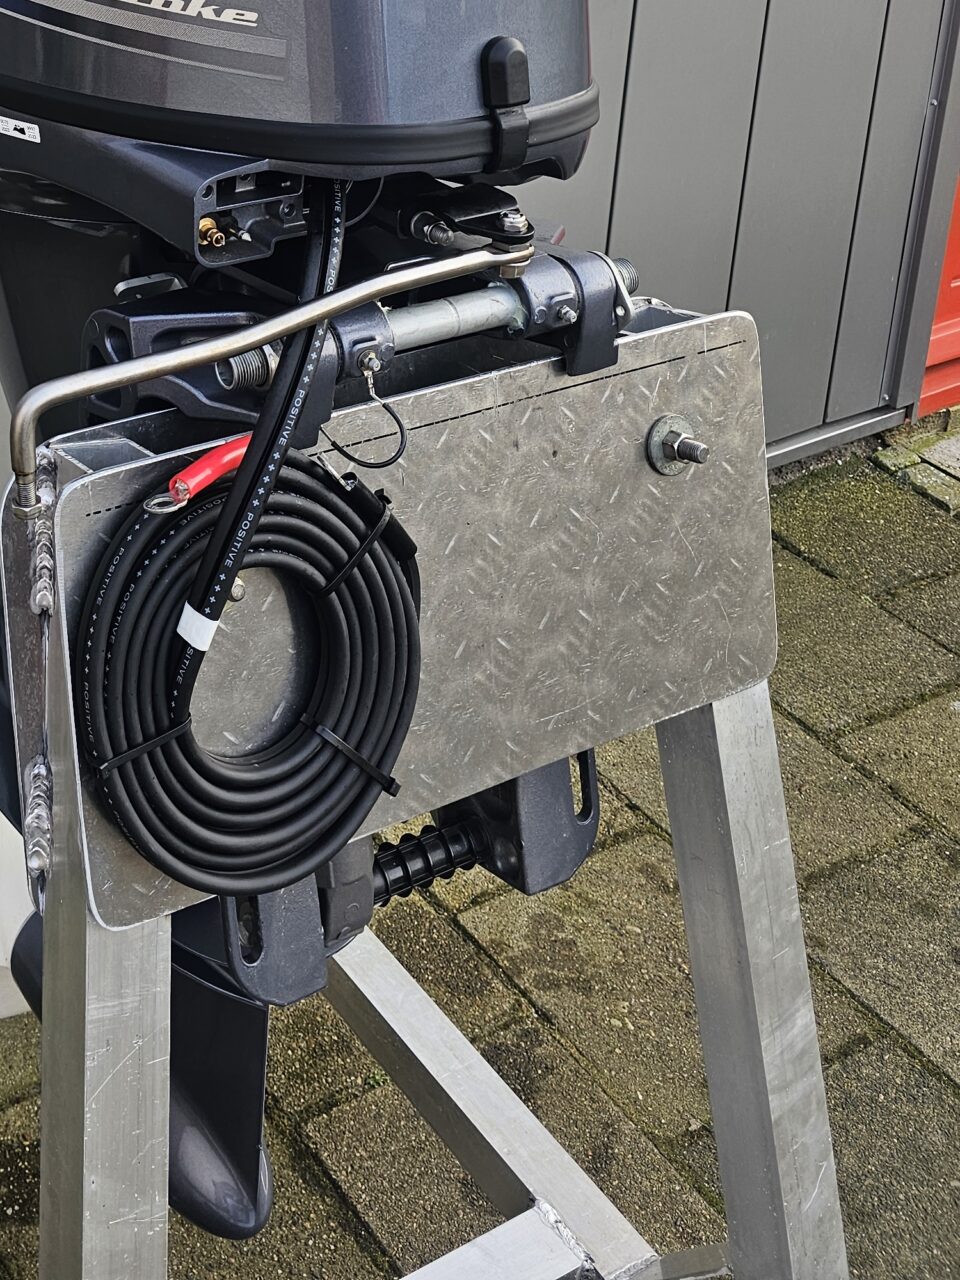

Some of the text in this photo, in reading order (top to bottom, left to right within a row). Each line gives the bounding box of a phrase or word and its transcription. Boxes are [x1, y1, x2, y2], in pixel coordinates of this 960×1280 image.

[333, 179, 342, 213] OSITIVE
[278, 389, 306, 446] POSITIVE
[224, 511, 255, 569] POSITIVE
[96, 547, 124, 606] POSITIVE
[110, 583, 135, 644] POSITIVE
[176, 646, 194, 684] SITIVE
